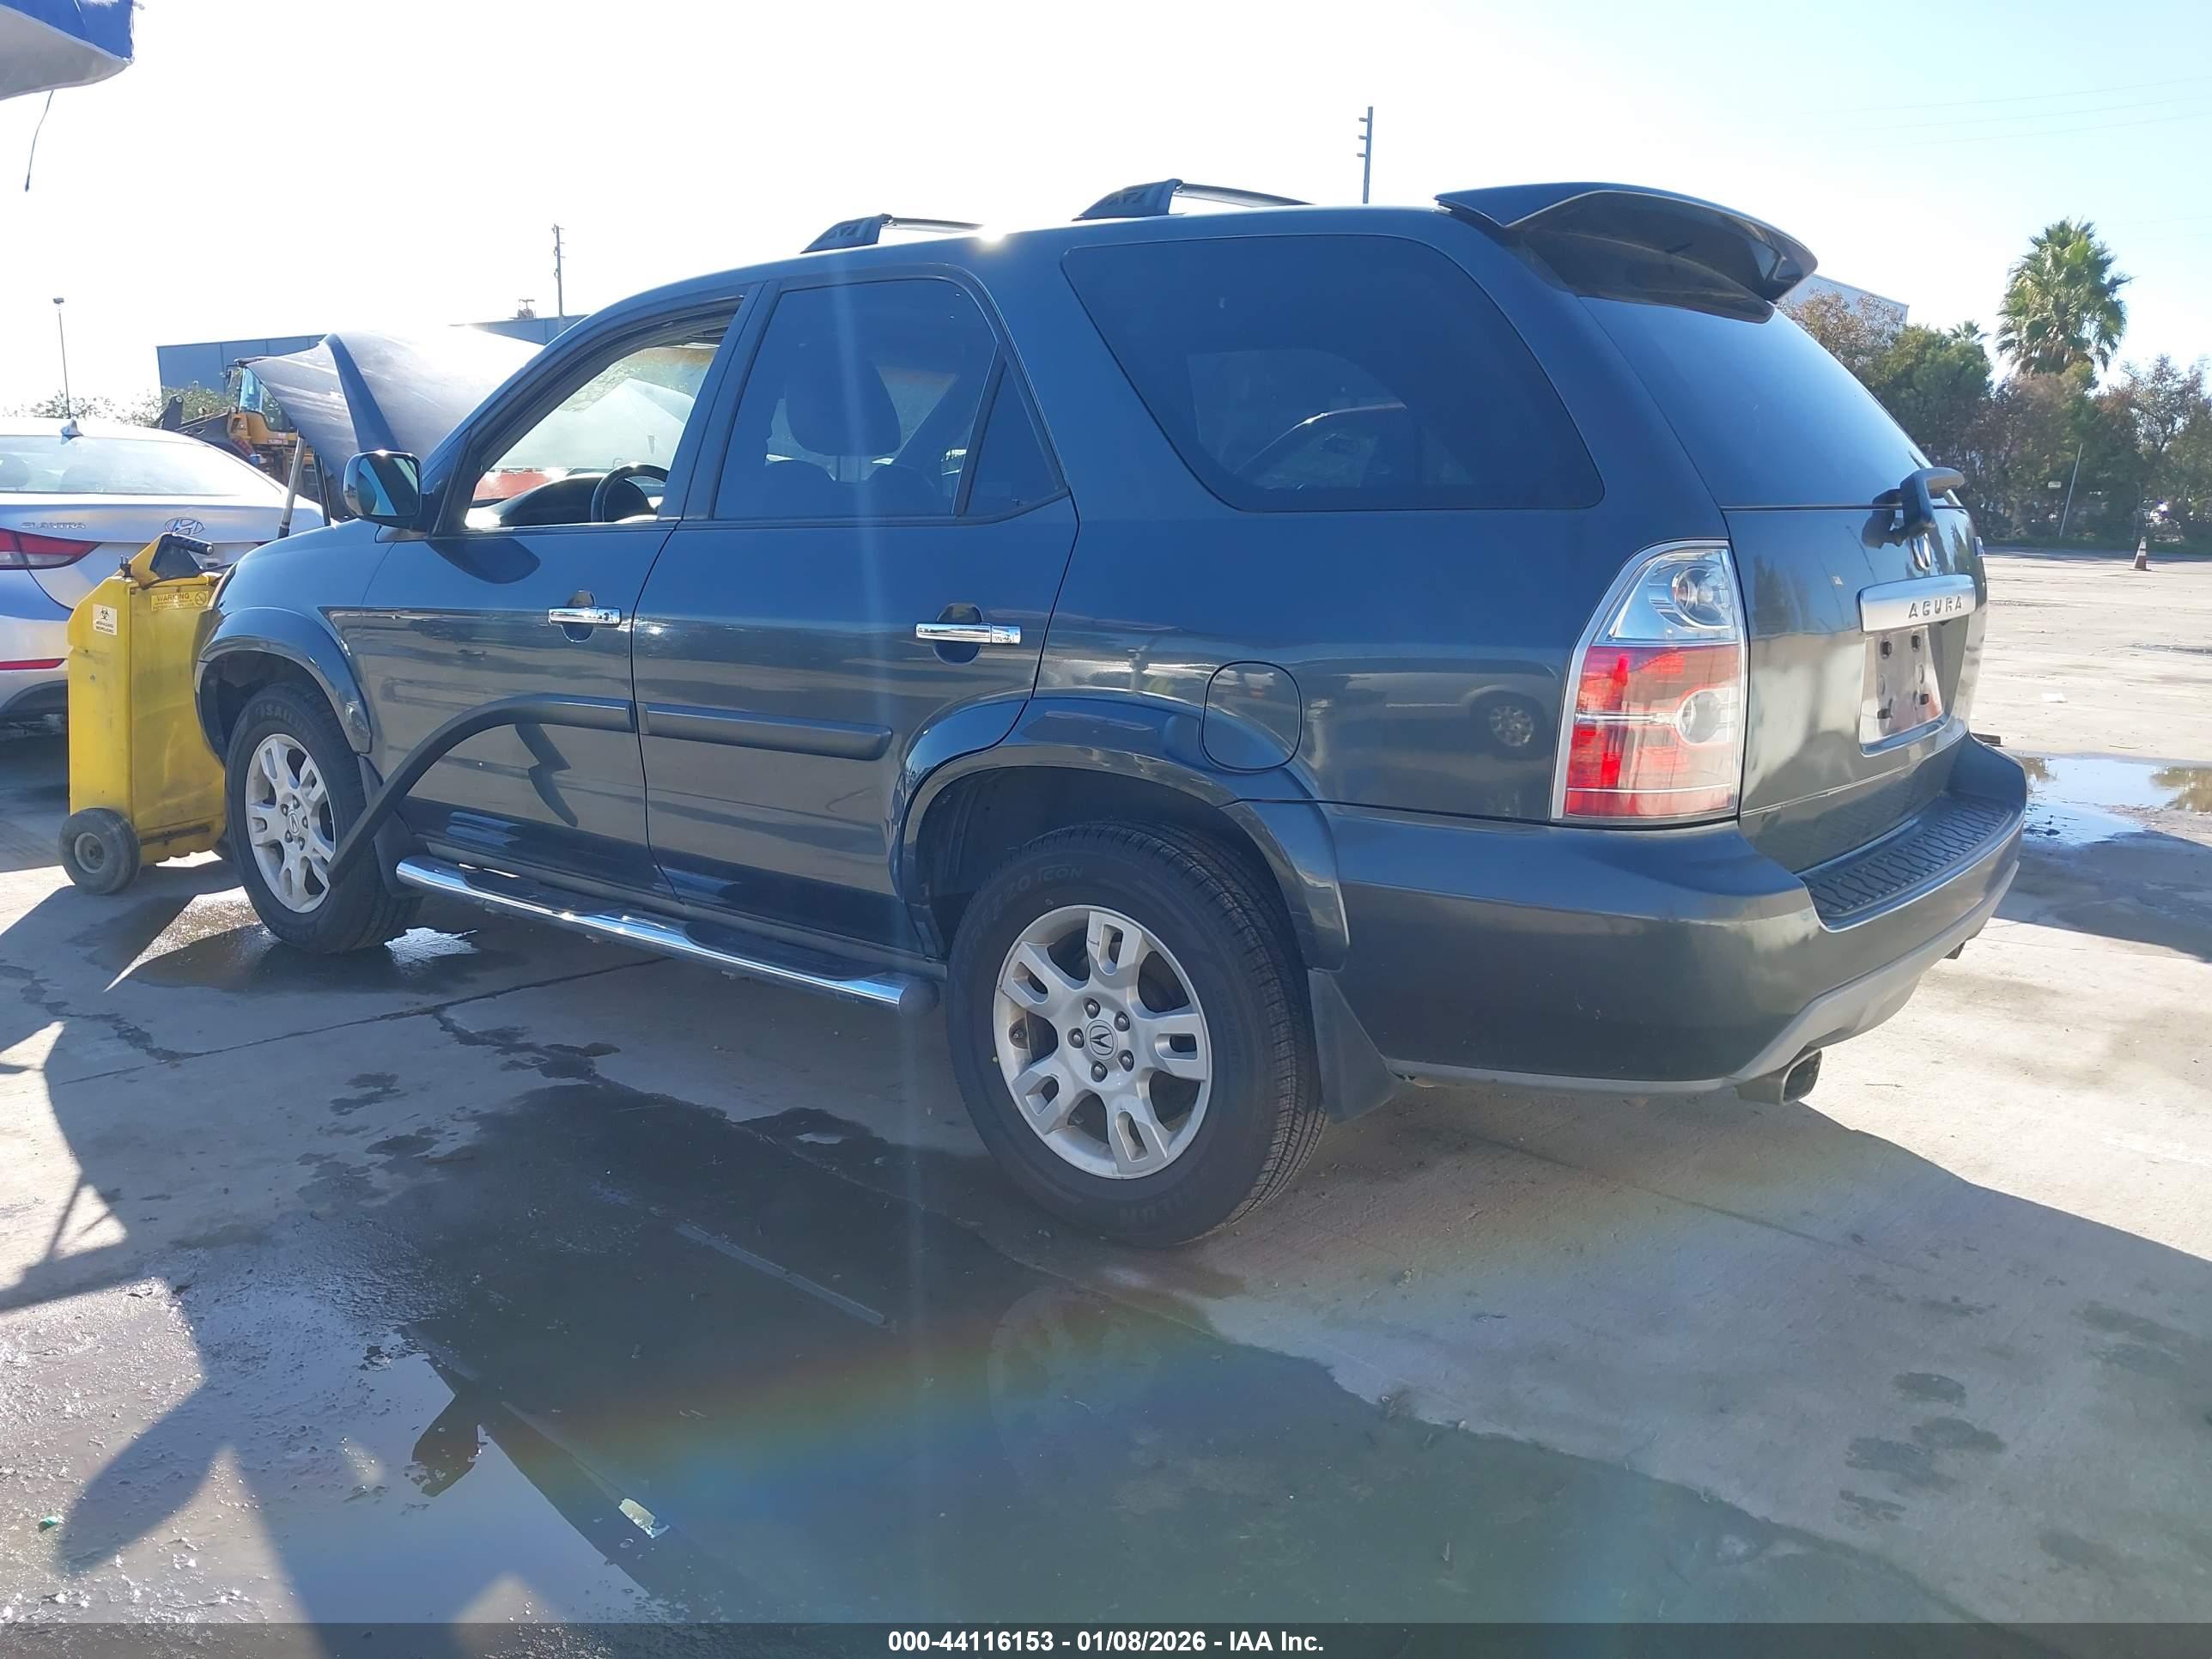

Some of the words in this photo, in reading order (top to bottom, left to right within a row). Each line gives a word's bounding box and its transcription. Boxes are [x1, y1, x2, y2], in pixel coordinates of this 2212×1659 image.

[20, 521, 87, 530] ELANTRA
[156, 592, 190, 602] WARNING
[1908, 596, 1962, 618] ACURA
